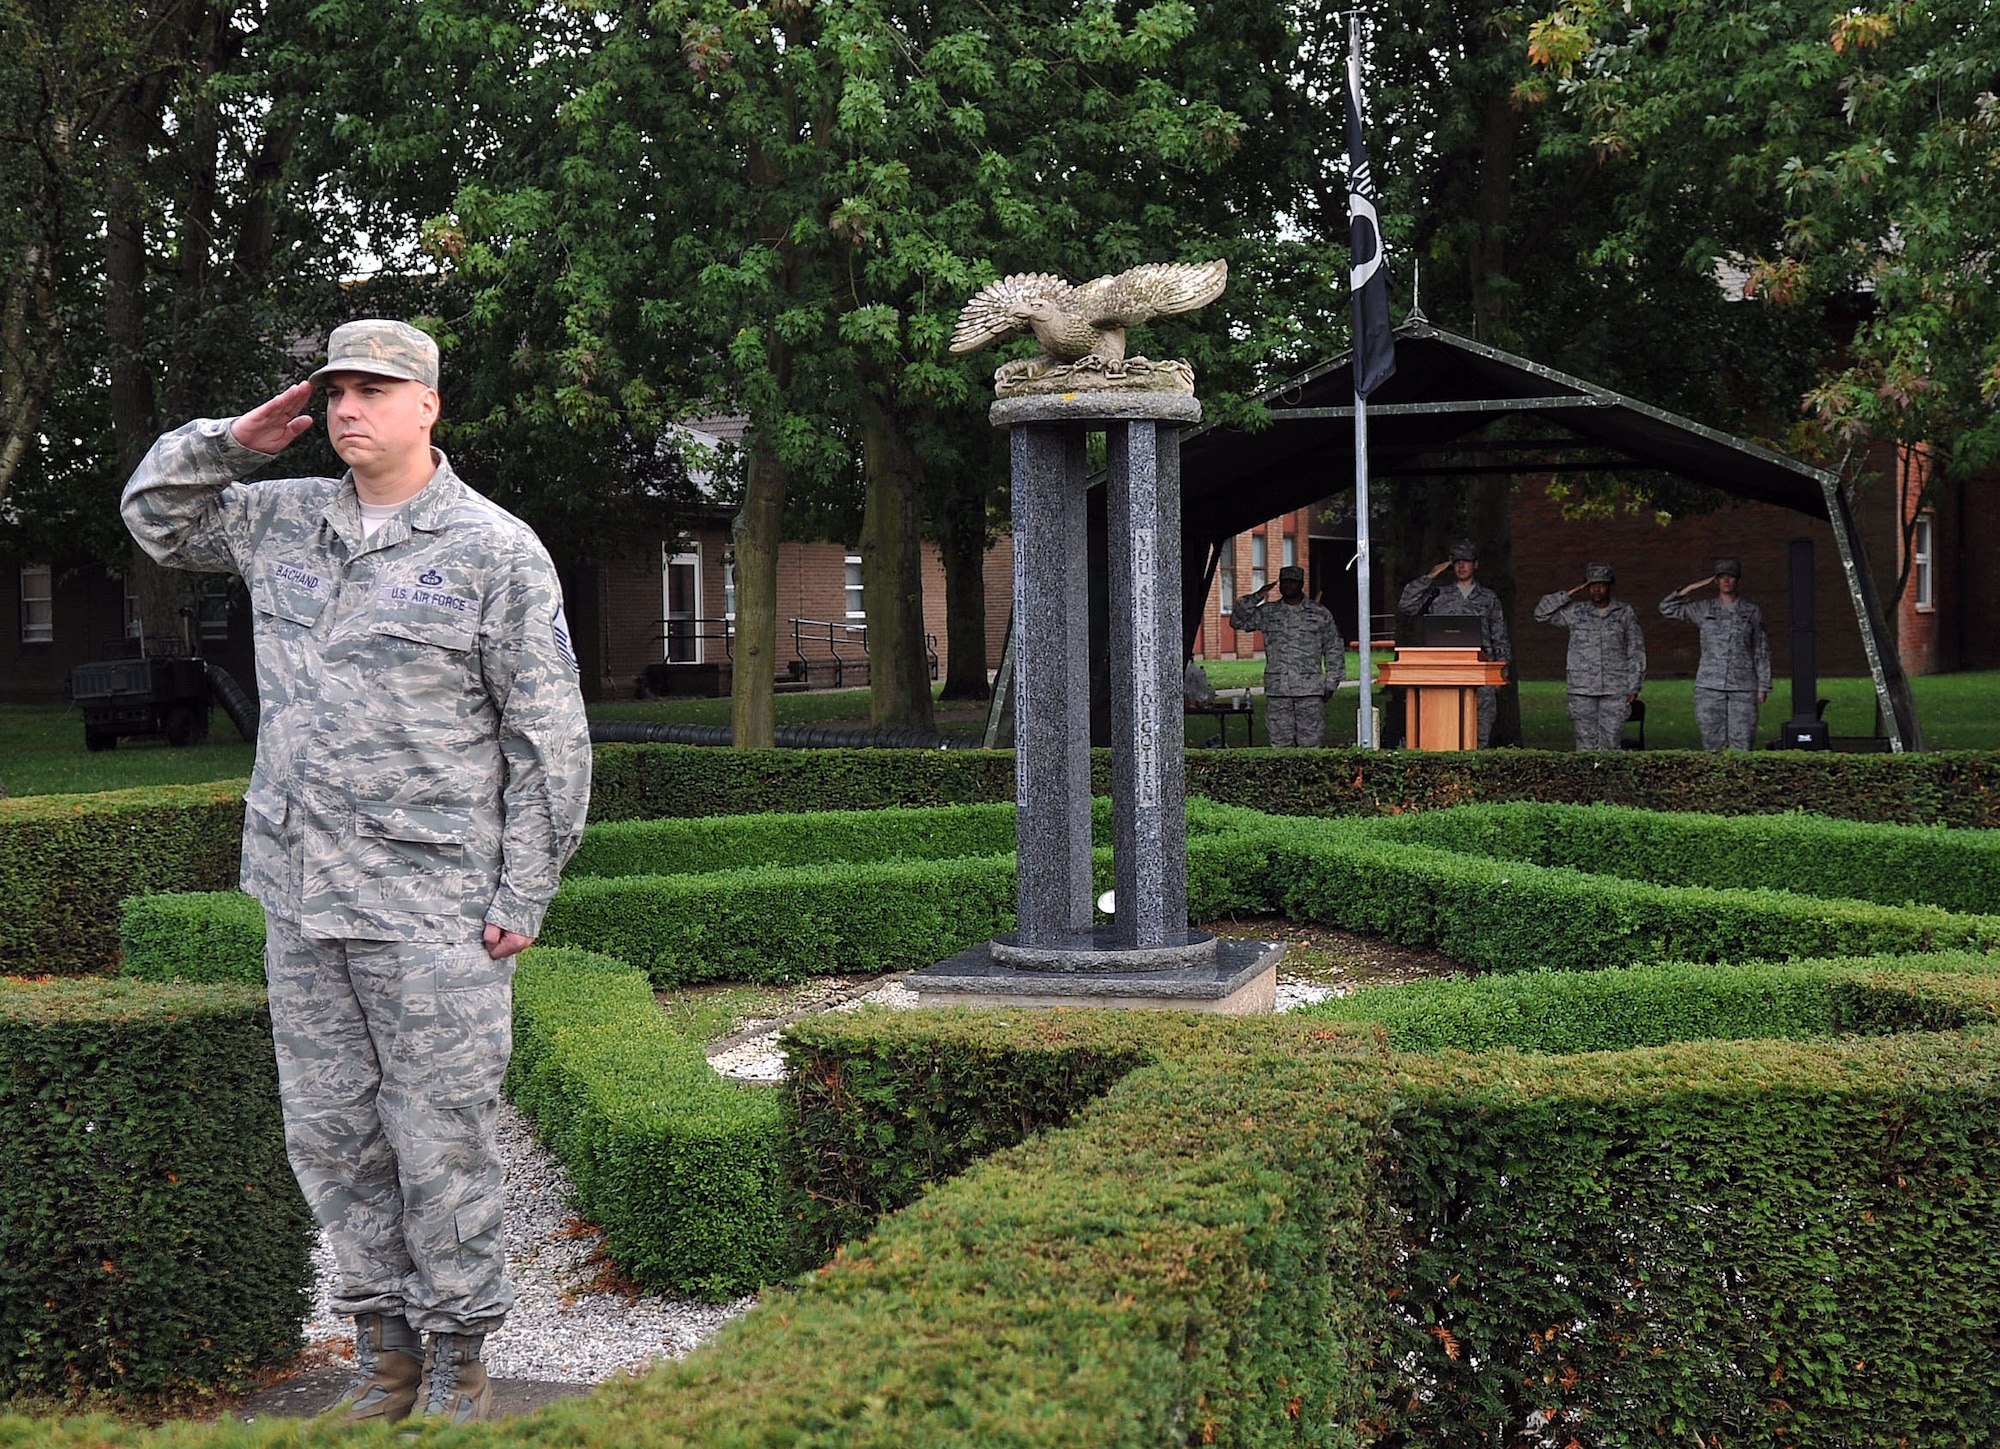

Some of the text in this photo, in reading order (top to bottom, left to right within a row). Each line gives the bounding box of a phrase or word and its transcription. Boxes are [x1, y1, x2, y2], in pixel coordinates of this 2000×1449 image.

[1015, 538, 1024, 577] YOU
[1137, 534, 1152, 576] YOU
[275, 564, 319, 589] BACHAND
[391, 588, 467, 611] U.S. AIR FORCE
[1016, 633, 1026, 674] NOT
[1139, 631, 1153, 673] NOT
[1140, 680, 1154, 802] FORGOTTEN
